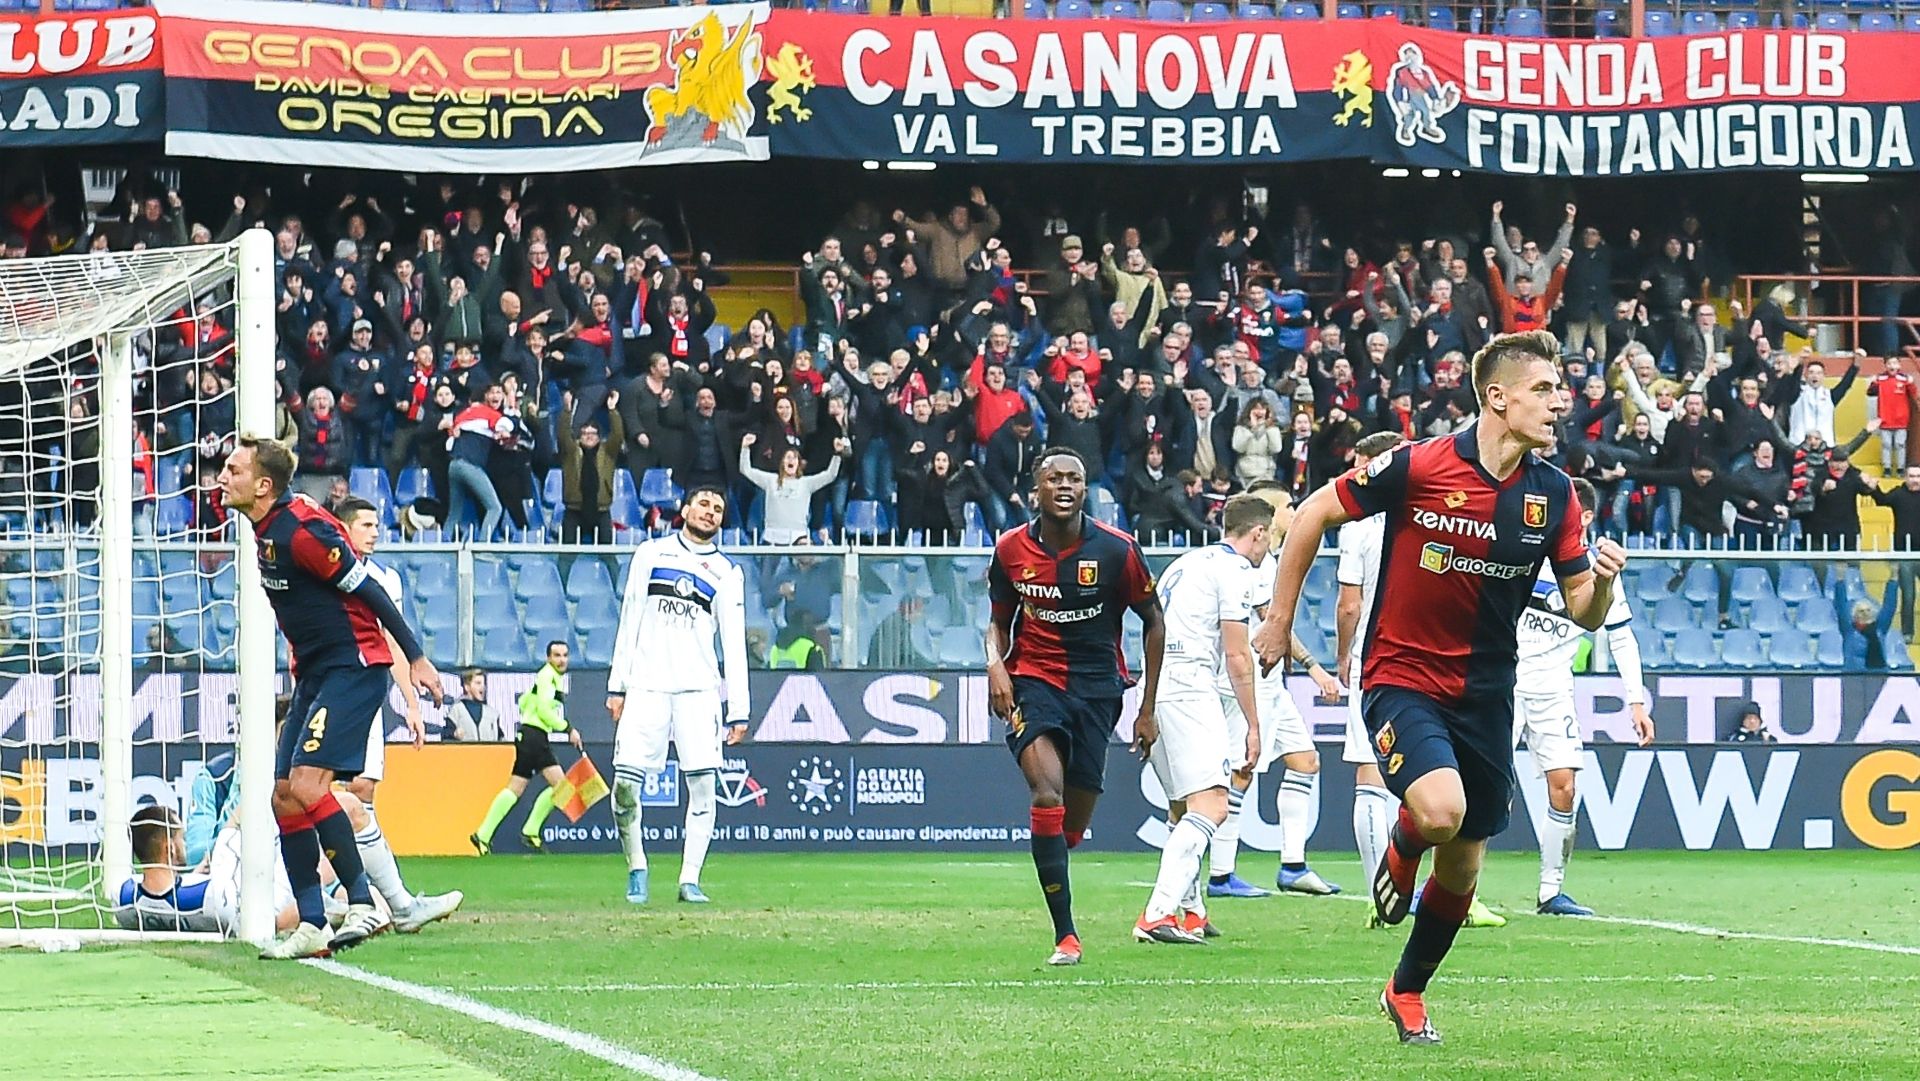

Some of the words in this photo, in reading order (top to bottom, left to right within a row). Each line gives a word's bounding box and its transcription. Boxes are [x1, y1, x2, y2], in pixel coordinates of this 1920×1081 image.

[462, 41, 663, 81] CLUB
[841, 29, 1298, 110] CASANOVA
[1463, 38, 1665, 107] GENOA
[1685, 33, 1848, 101] CLUB
[0, 82, 140, 130] ADI
[892, 113, 999, 156] VAL
[1030, 114, 1283, 157] TREBBIA
[1467, 103, 1916, 177] FONTANIGORDA
[1452, 556, 1535, 580] GIOCHE
[307, 706, 328, 740] 4
[1563, 714, 1581, 739] 2
[857, 768, 925, 781] AGENZIA
[857, 791, 925, 804] MONOPOLI
[543, 825, 588, 842] gioco
[591, 825, 602, 840] è
[663, 825, 678, 840] ai
[734, 825, 750, 840] di
[754, 825, 770, 840] 18
[772, 825, 807, 840] anni
[809, 828, 820, 840] e
[823, 826, 854, 843] può
[856, 828, 916, 840] causare
[919, 825, 1008, 843] dipendenza
